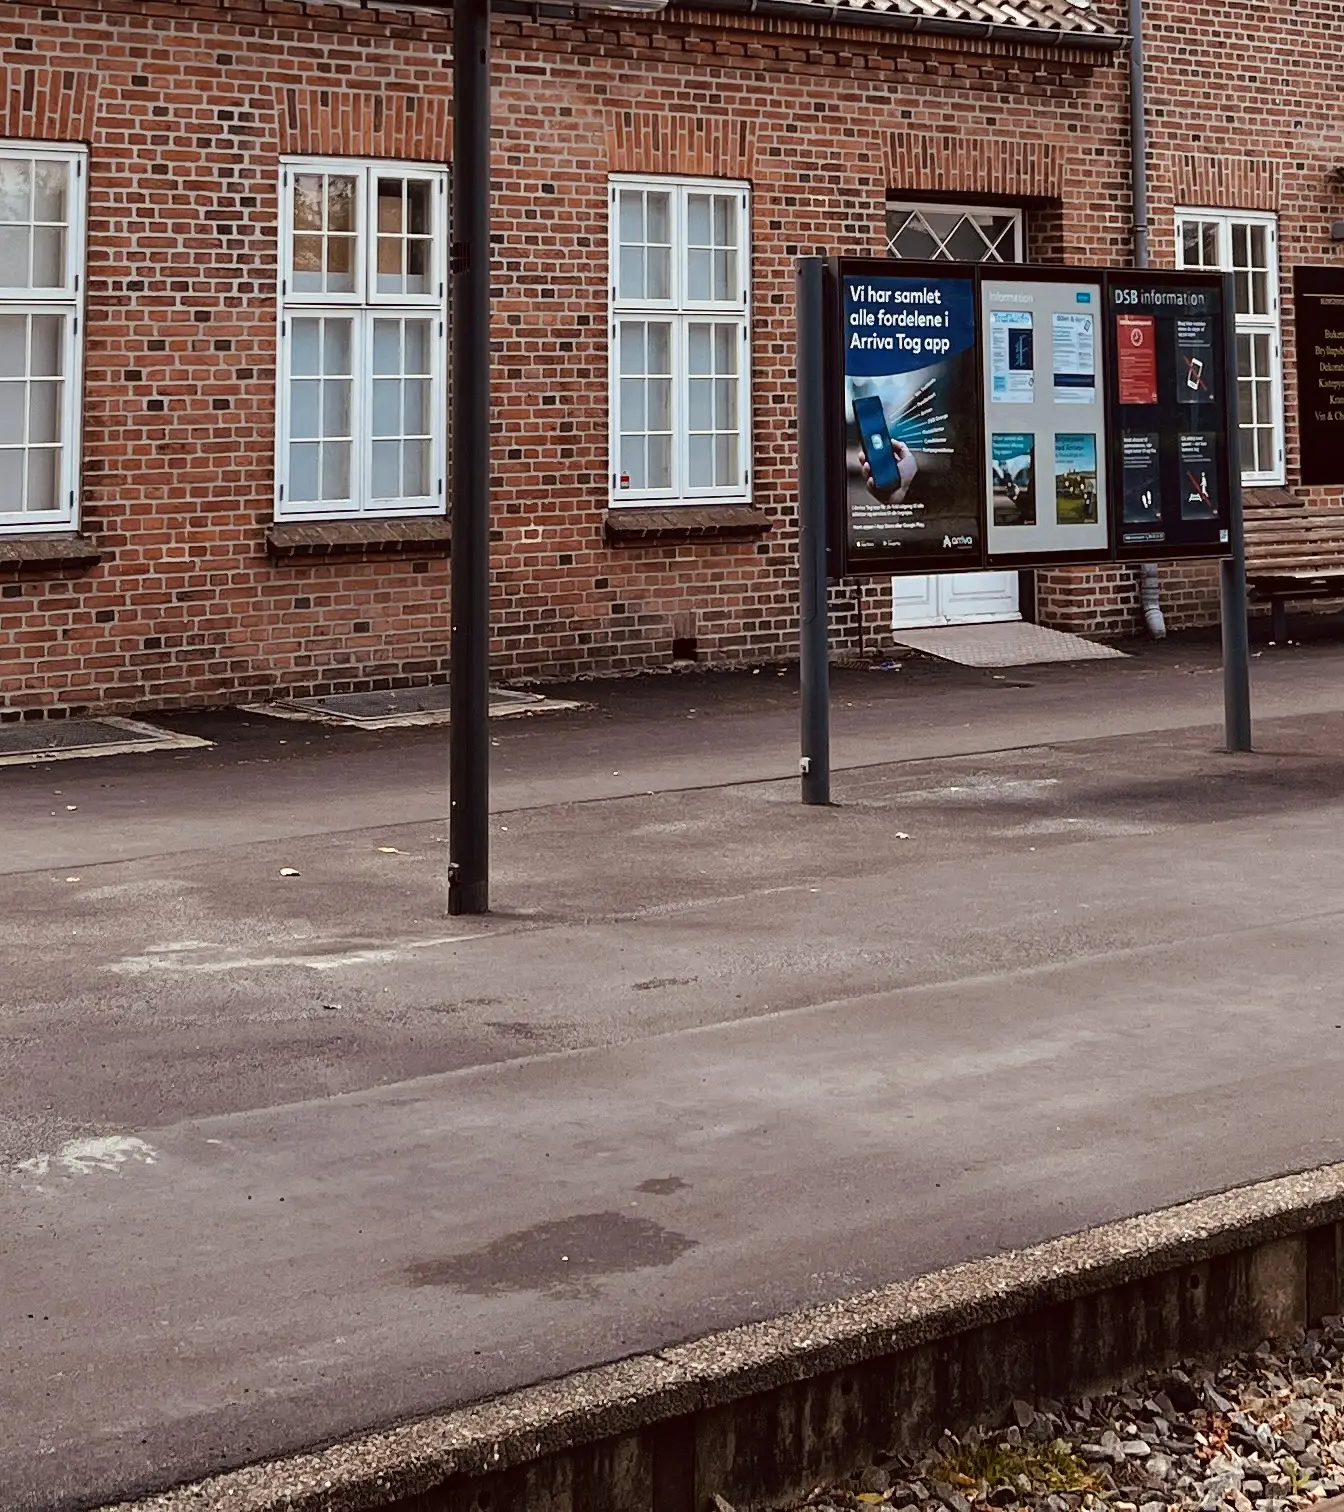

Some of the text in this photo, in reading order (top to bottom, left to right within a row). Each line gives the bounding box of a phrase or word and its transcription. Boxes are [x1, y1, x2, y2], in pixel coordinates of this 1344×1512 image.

[849, 285, 942, 305] Vi har samlet
[1114, 289, 1205, 306] DSB information
[849, 308, 949, 328] alle fordelene i
[849, 332, 950, 355] Arriva Tog app
[1327, 410, 1333, 421] &
